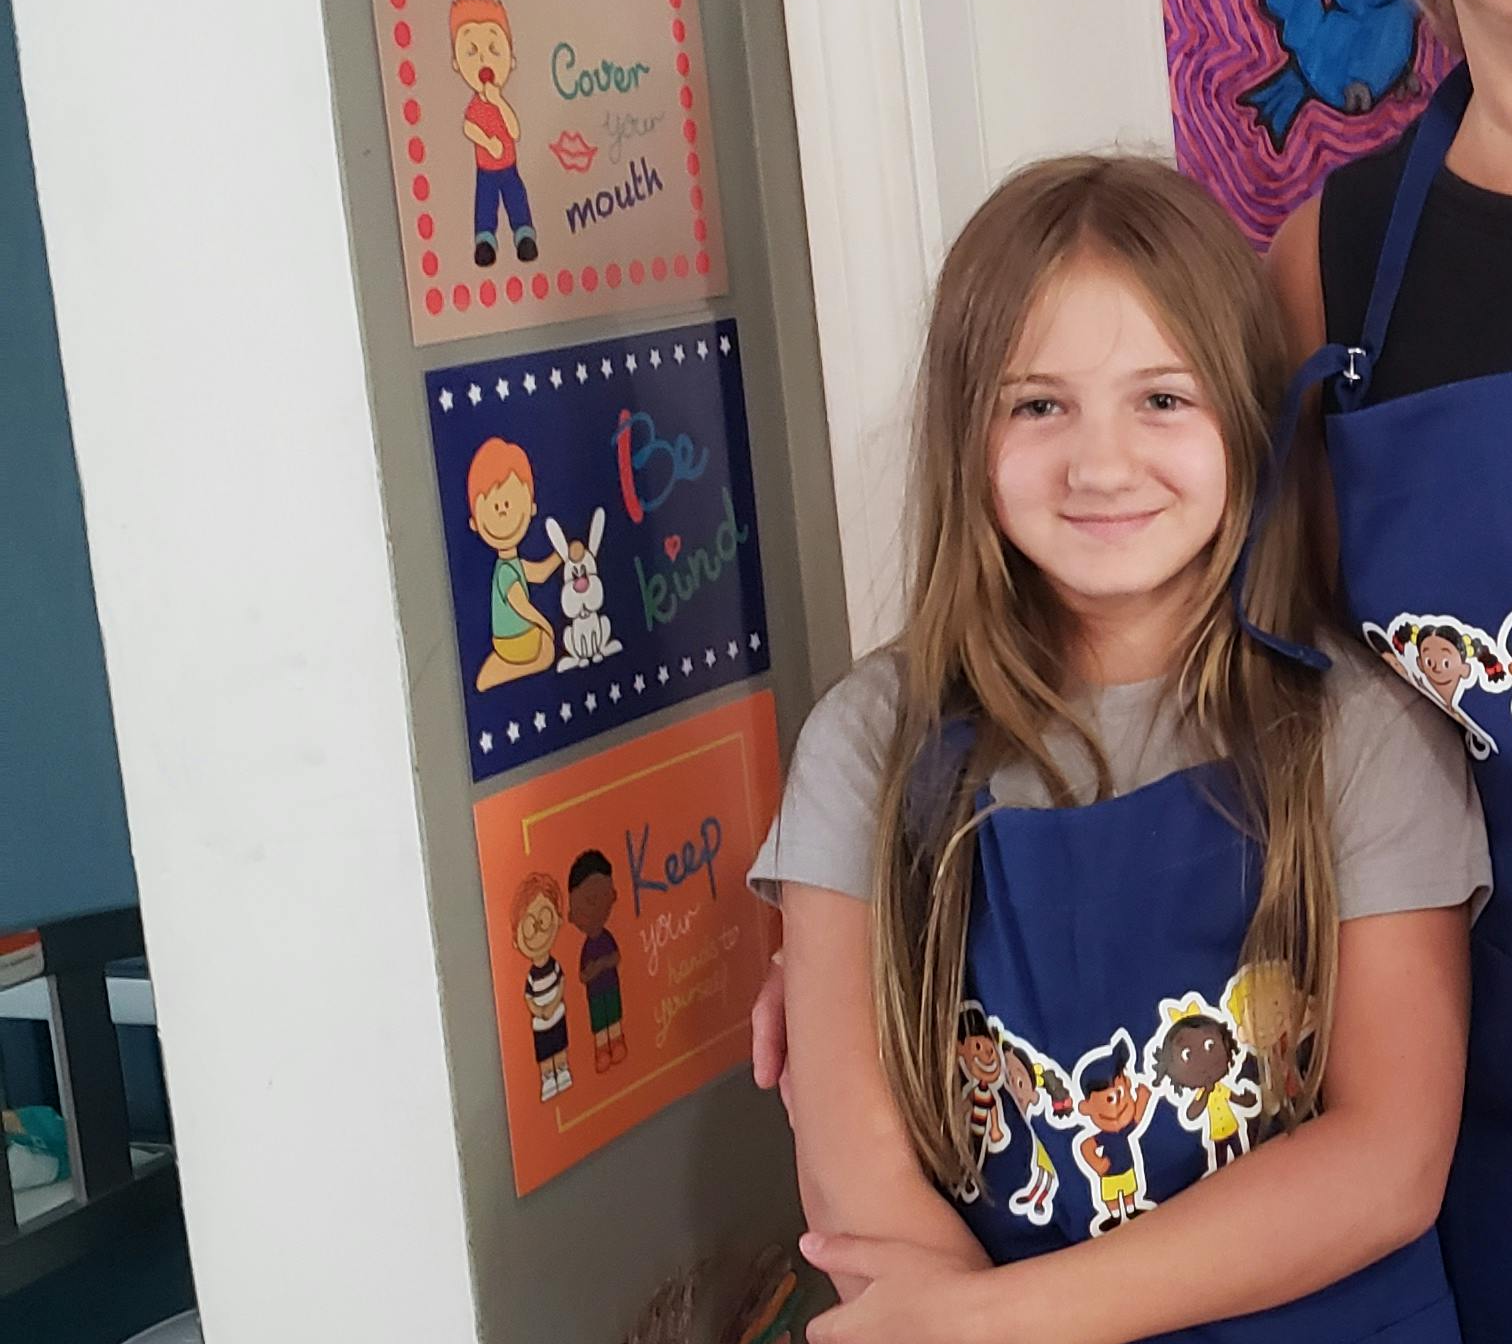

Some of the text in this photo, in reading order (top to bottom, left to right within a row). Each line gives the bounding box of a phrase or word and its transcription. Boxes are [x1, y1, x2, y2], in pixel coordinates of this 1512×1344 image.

[551, 41, 651, 101] Cover
[565, 156, 664, 234] mouth
[611, 408, 709, 524] Be
[634, 486, 750, 632] kind
[625, 816, 723, 918] Keep
[639, 902, 701, 977] your
